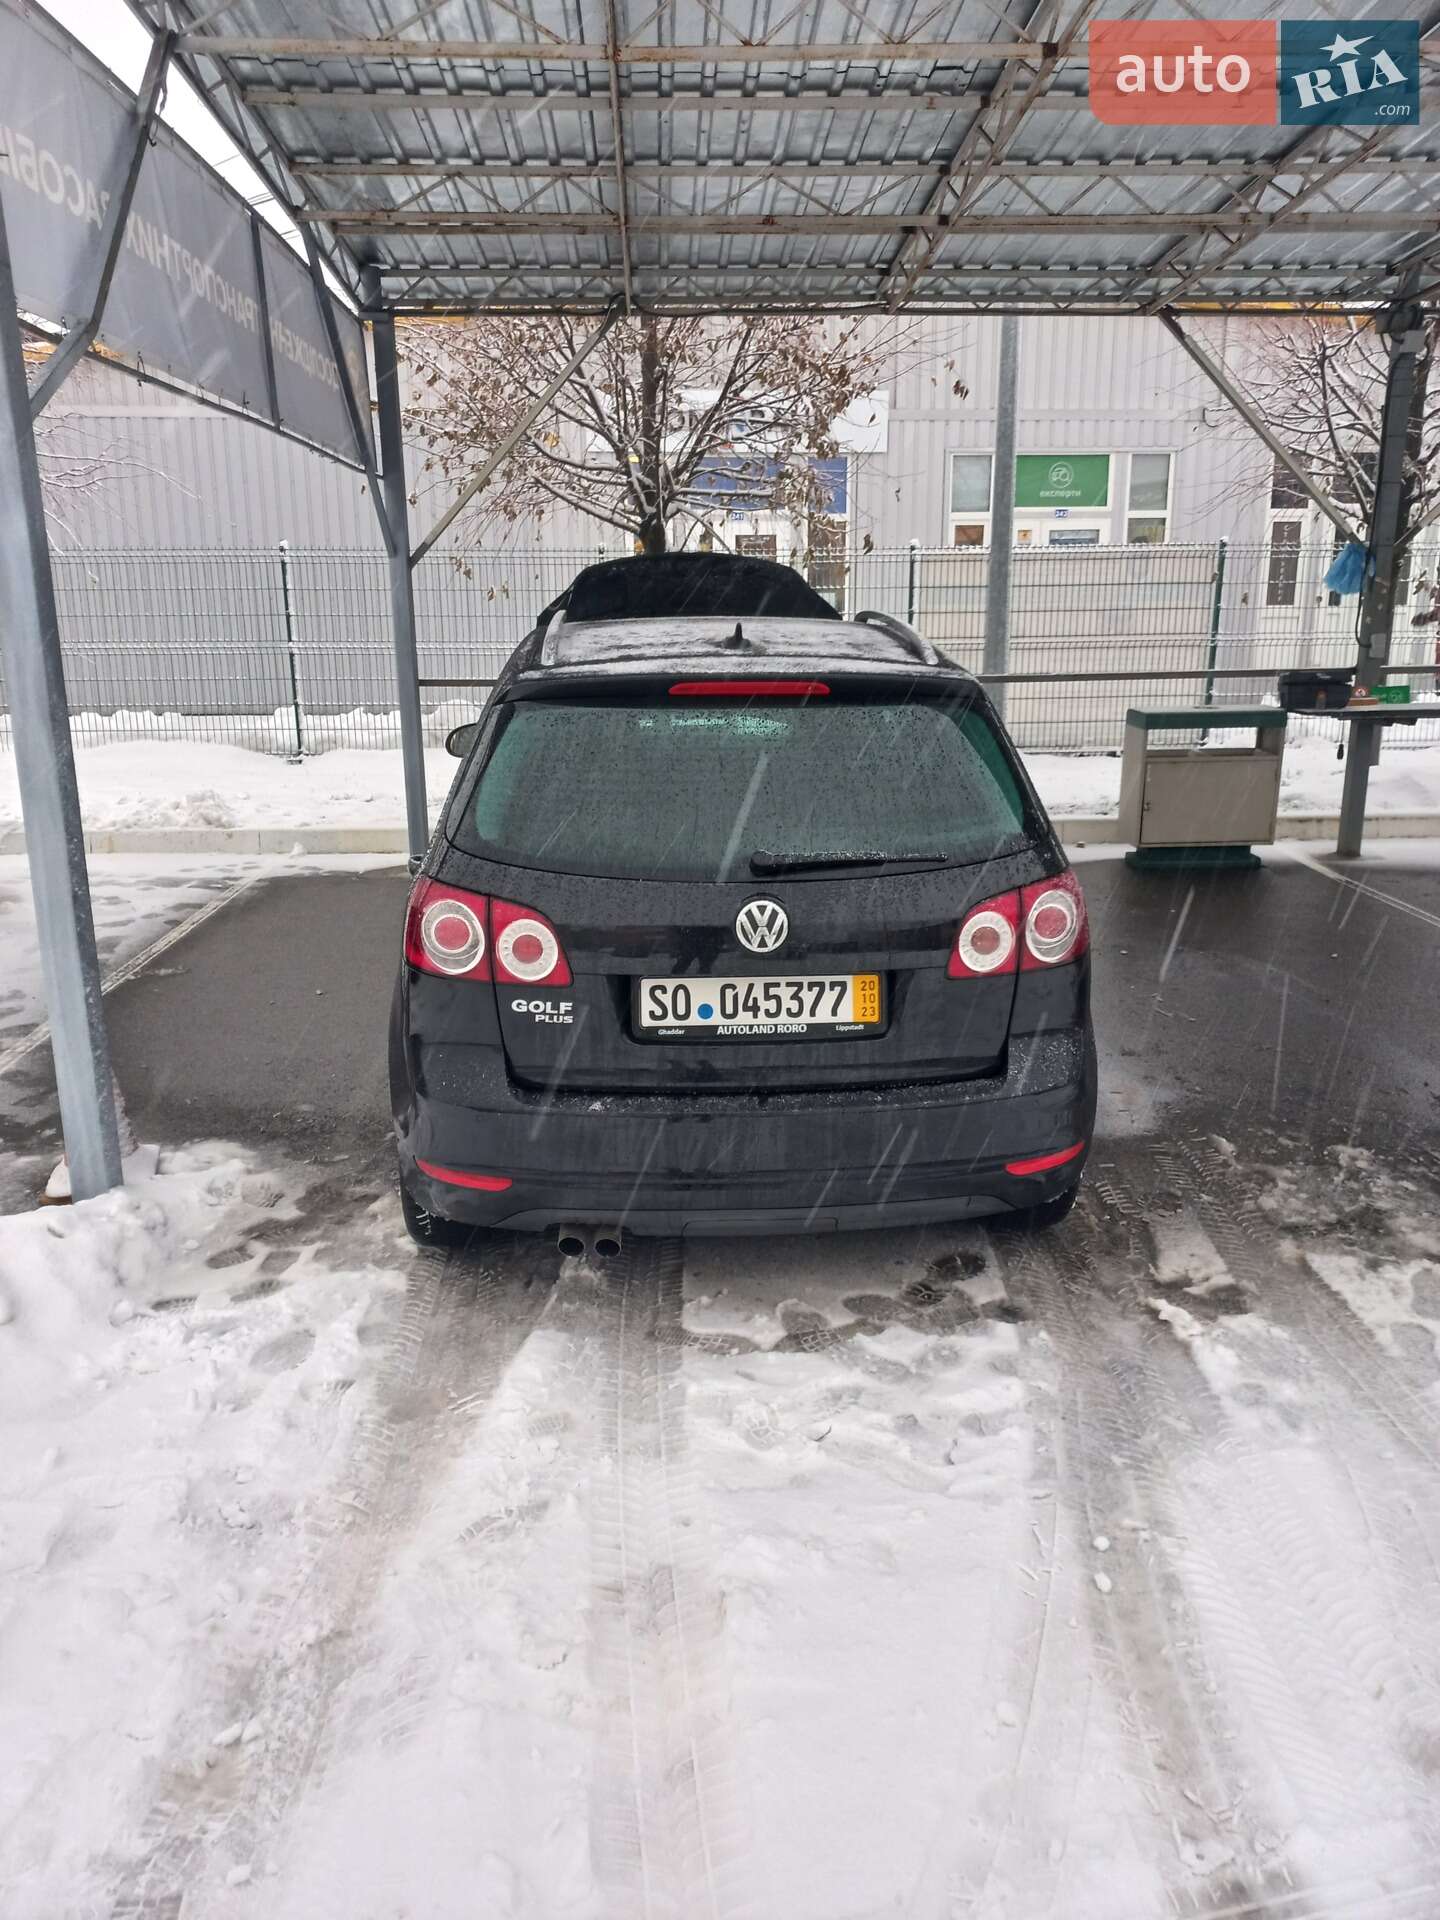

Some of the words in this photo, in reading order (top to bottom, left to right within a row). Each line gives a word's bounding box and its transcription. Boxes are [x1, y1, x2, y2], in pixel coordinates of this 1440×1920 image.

[860, 980, 876, 991] 20
[648, 983, 691, 1021] SO
[719, 980, 848, 1020] 045377
[861, 993, 876, 1003] 10
[511, 999, 574, 1014] GOLF
[861, 1006, 876, 1017] 23
[535, 1014, 574, 1024] PLUS
[716, 1025, 775, 1035] AUTOLAND
[777, 1024, 807, 1033] RORO
